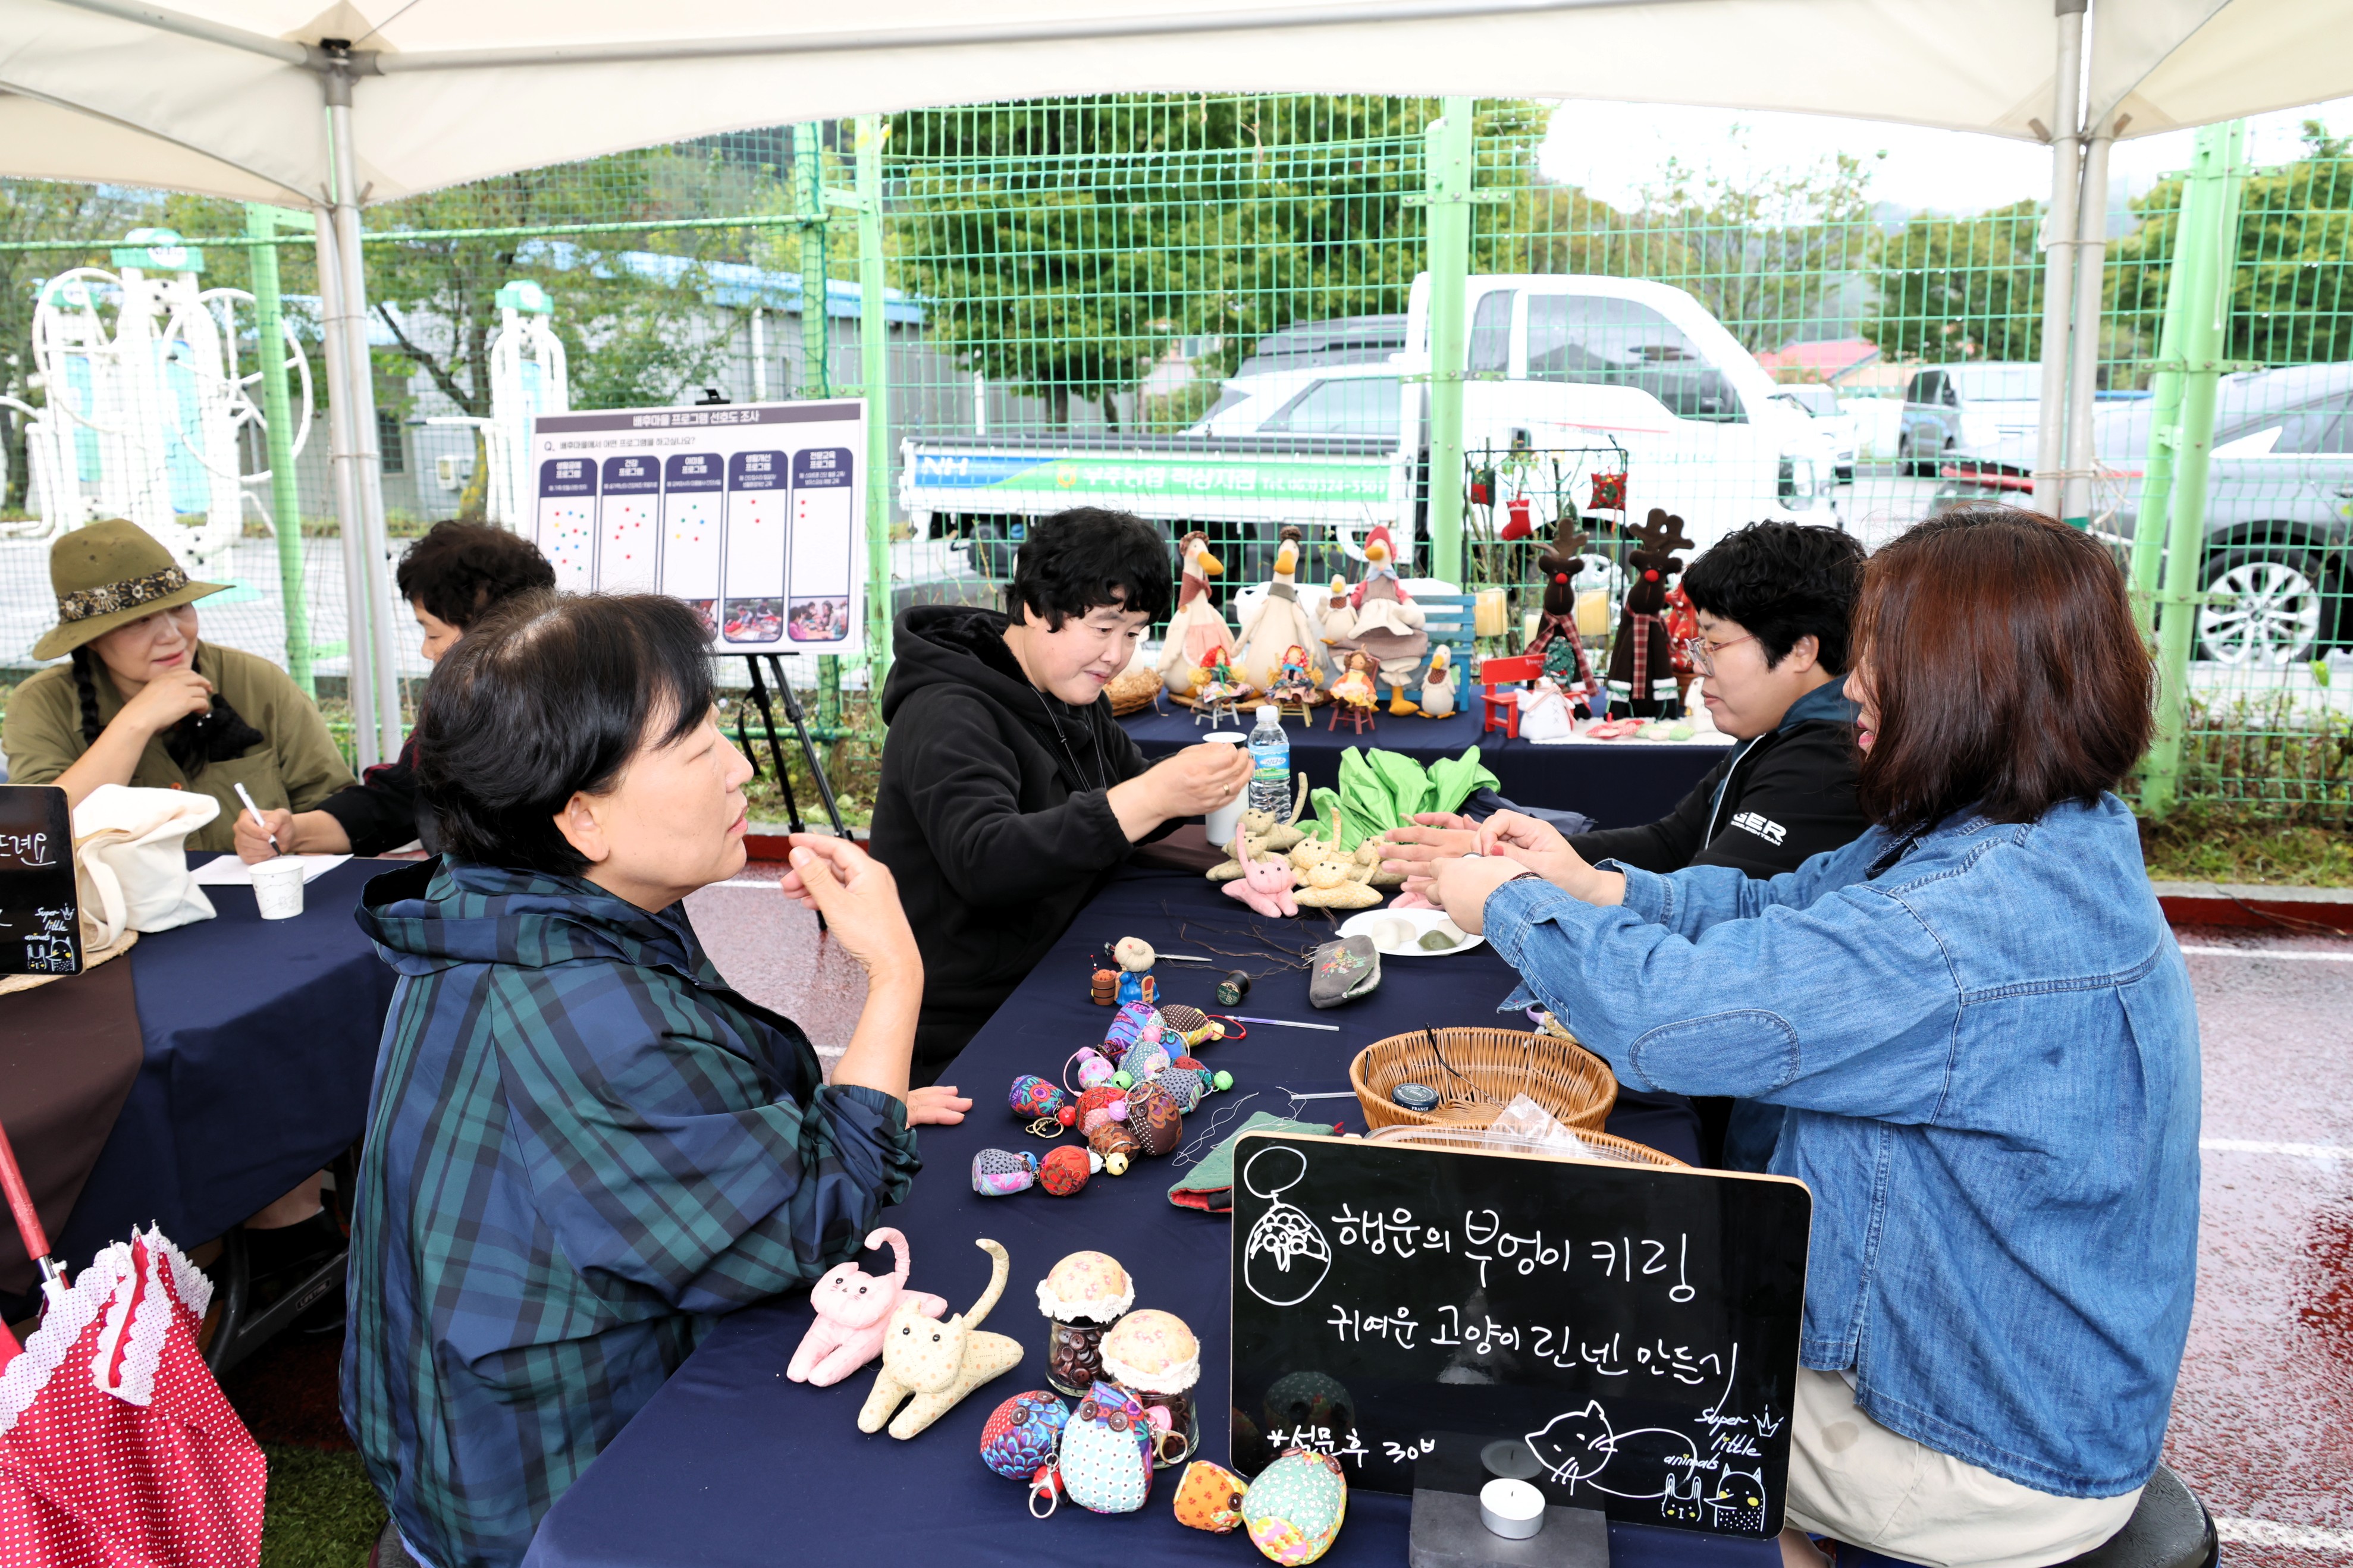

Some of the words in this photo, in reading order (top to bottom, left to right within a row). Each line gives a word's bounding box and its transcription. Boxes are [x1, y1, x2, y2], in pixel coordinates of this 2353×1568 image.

[671, 413, 709, 426] 프로그램
[710, 411, 738, 424] 선호도
[740, 410, 760, 423] 조사
[619, 467, 645, 476] 프로그램
[682, 465, 708, 474] 프로그램
[745, 463, 772, 472] 프로그램
[810, 460, 836, 469] 프로그램
[921, 457, 968, 476] NH
[556, 470, 582, 479] 프로그램
[1761, 832, 1781, 847] TEAM
[34, 906, 60, 923] Super
[45, 919, 69, 932] little
[24, 931, 51, 941] animals
[1331, 1203, 1451, 1255] 행운의
[1463, 1208, 1571, 1288] 부엉이
[1591, 1232, 1696, 1303] 키링
[1326, 1305, 1419, 1349] 귀여운
[1430, 1306, 1520, 1355] 고양이
[1637, 1341, 1739, 1423] 만들기
[1694, 1406, 1749, 1437] Super
[1711, 1432, 1762, 1457] little
[1664, 1452, 1721, 1470] animals
